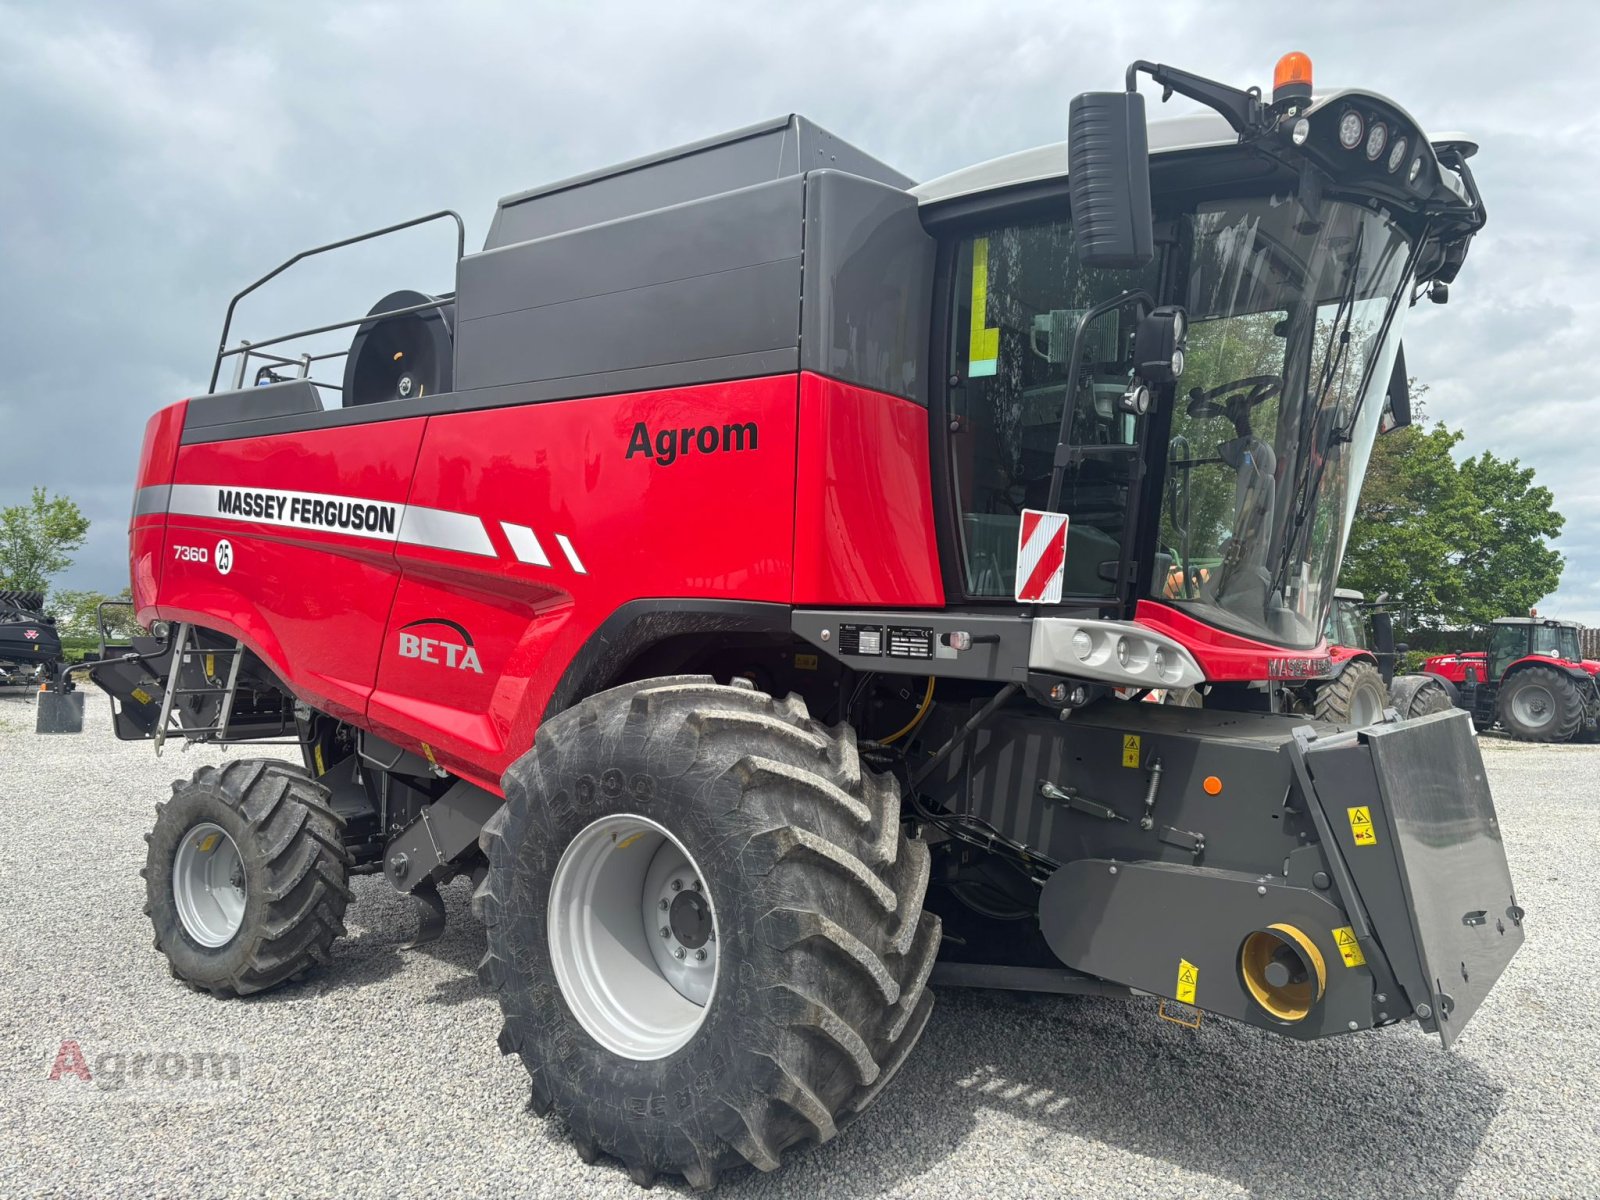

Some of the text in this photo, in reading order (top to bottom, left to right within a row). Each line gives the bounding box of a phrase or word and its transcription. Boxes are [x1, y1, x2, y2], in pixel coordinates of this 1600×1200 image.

[625, 421, 758, 467] Agrom
[217, 489, 396, 535] MASSEY FERGUSON
[172, 544, 209, 563] 7360
[218, 543, 230, 571] 25
[398, 632, 485, 674] BETA
